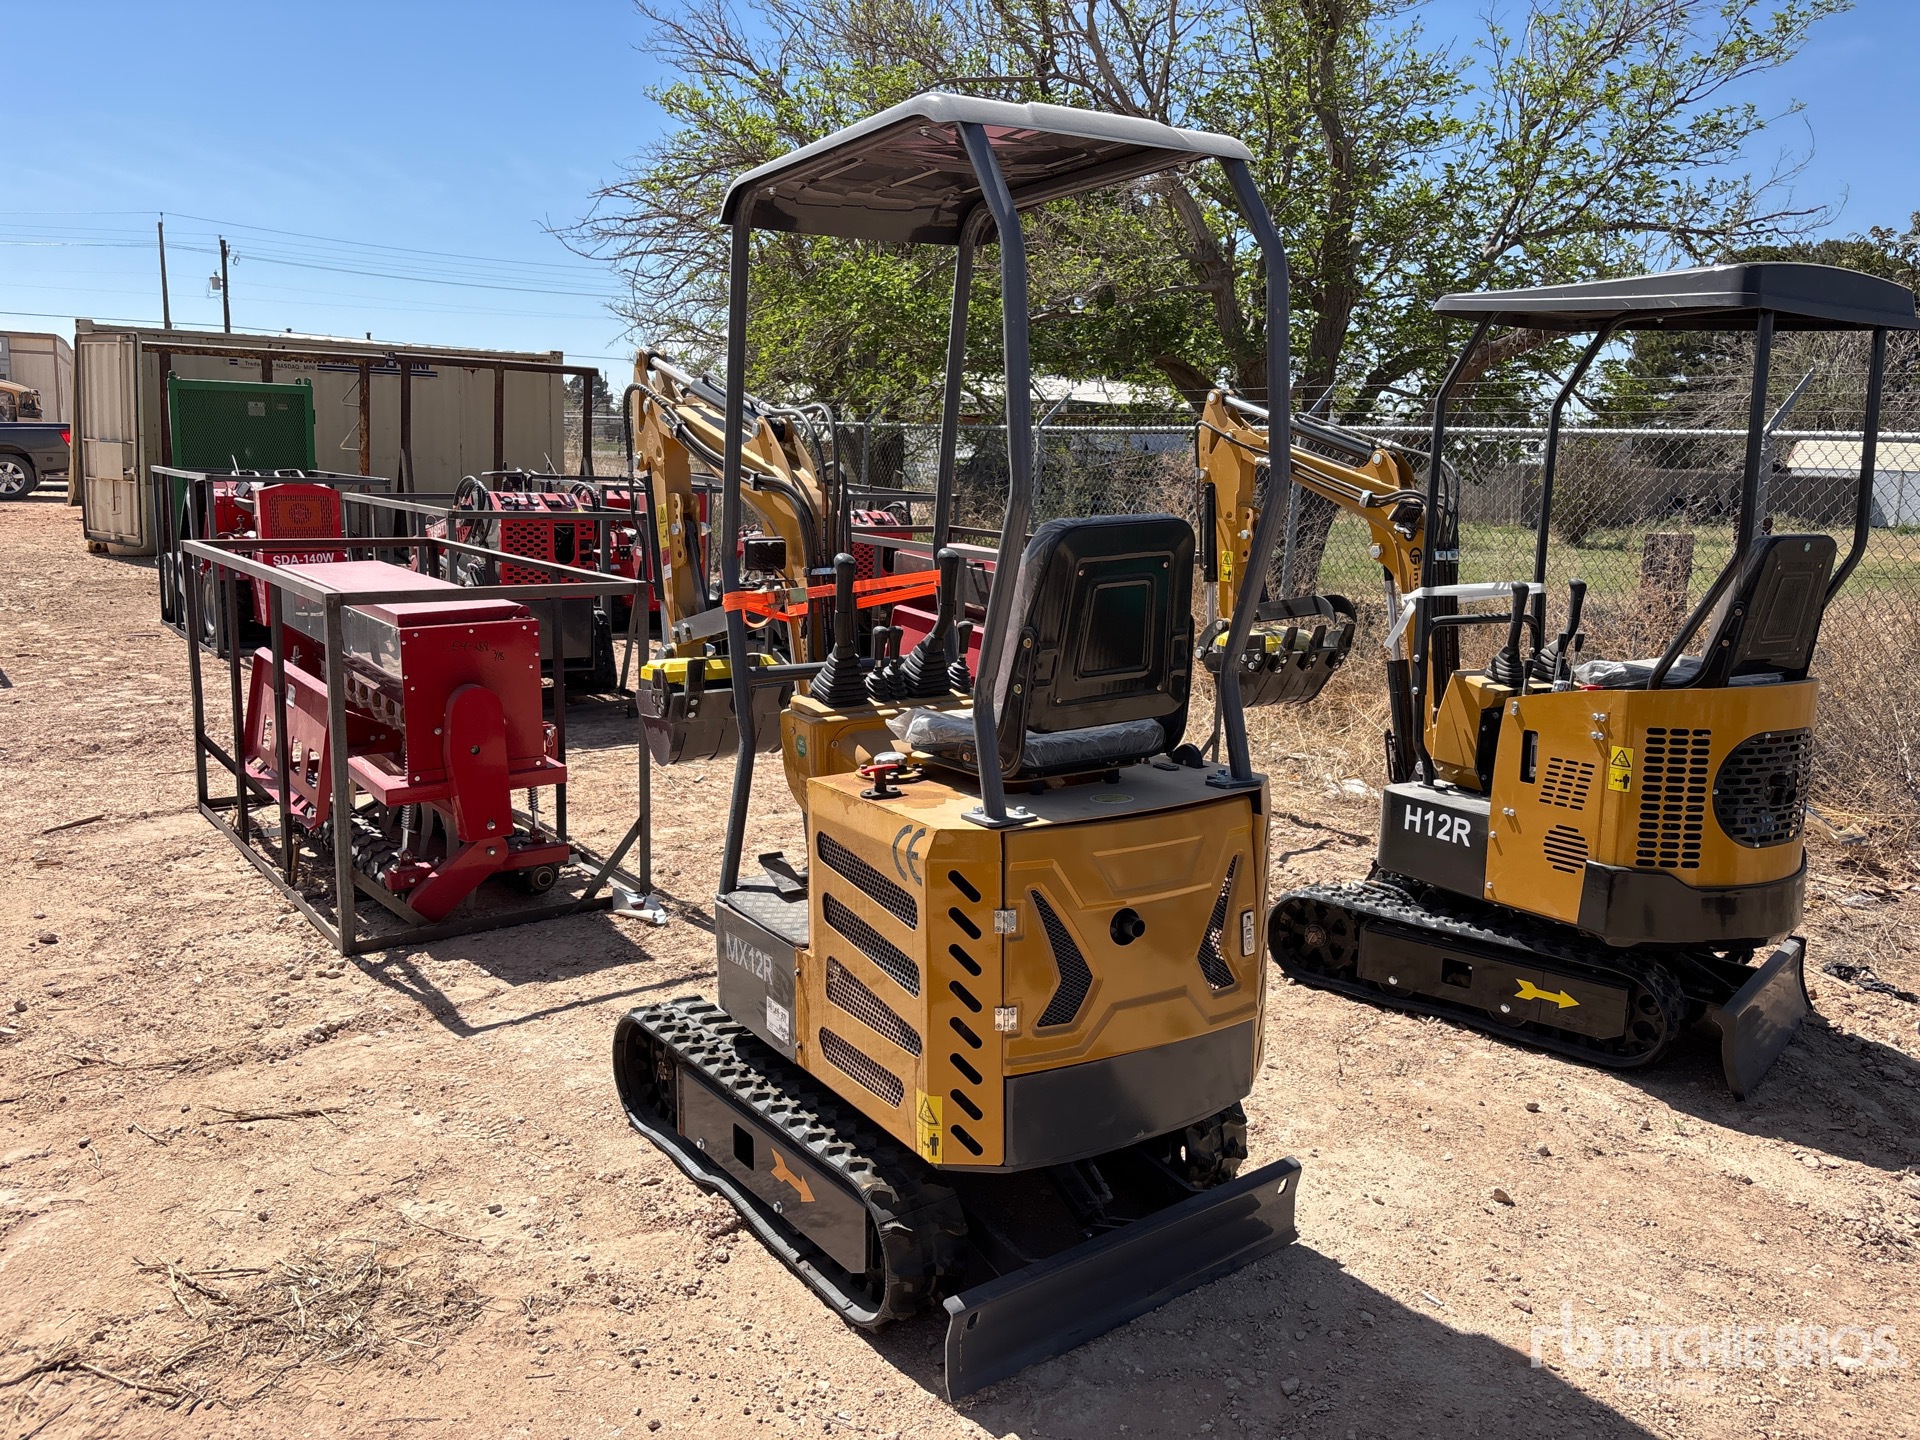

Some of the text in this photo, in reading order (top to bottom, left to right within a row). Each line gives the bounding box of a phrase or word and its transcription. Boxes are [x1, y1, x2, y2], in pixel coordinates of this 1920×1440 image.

[272, 552, 335, 566] SDA-140W
[1403, 804, 1472, 848] H12R
[725, 931, 774, 986] MX12R
